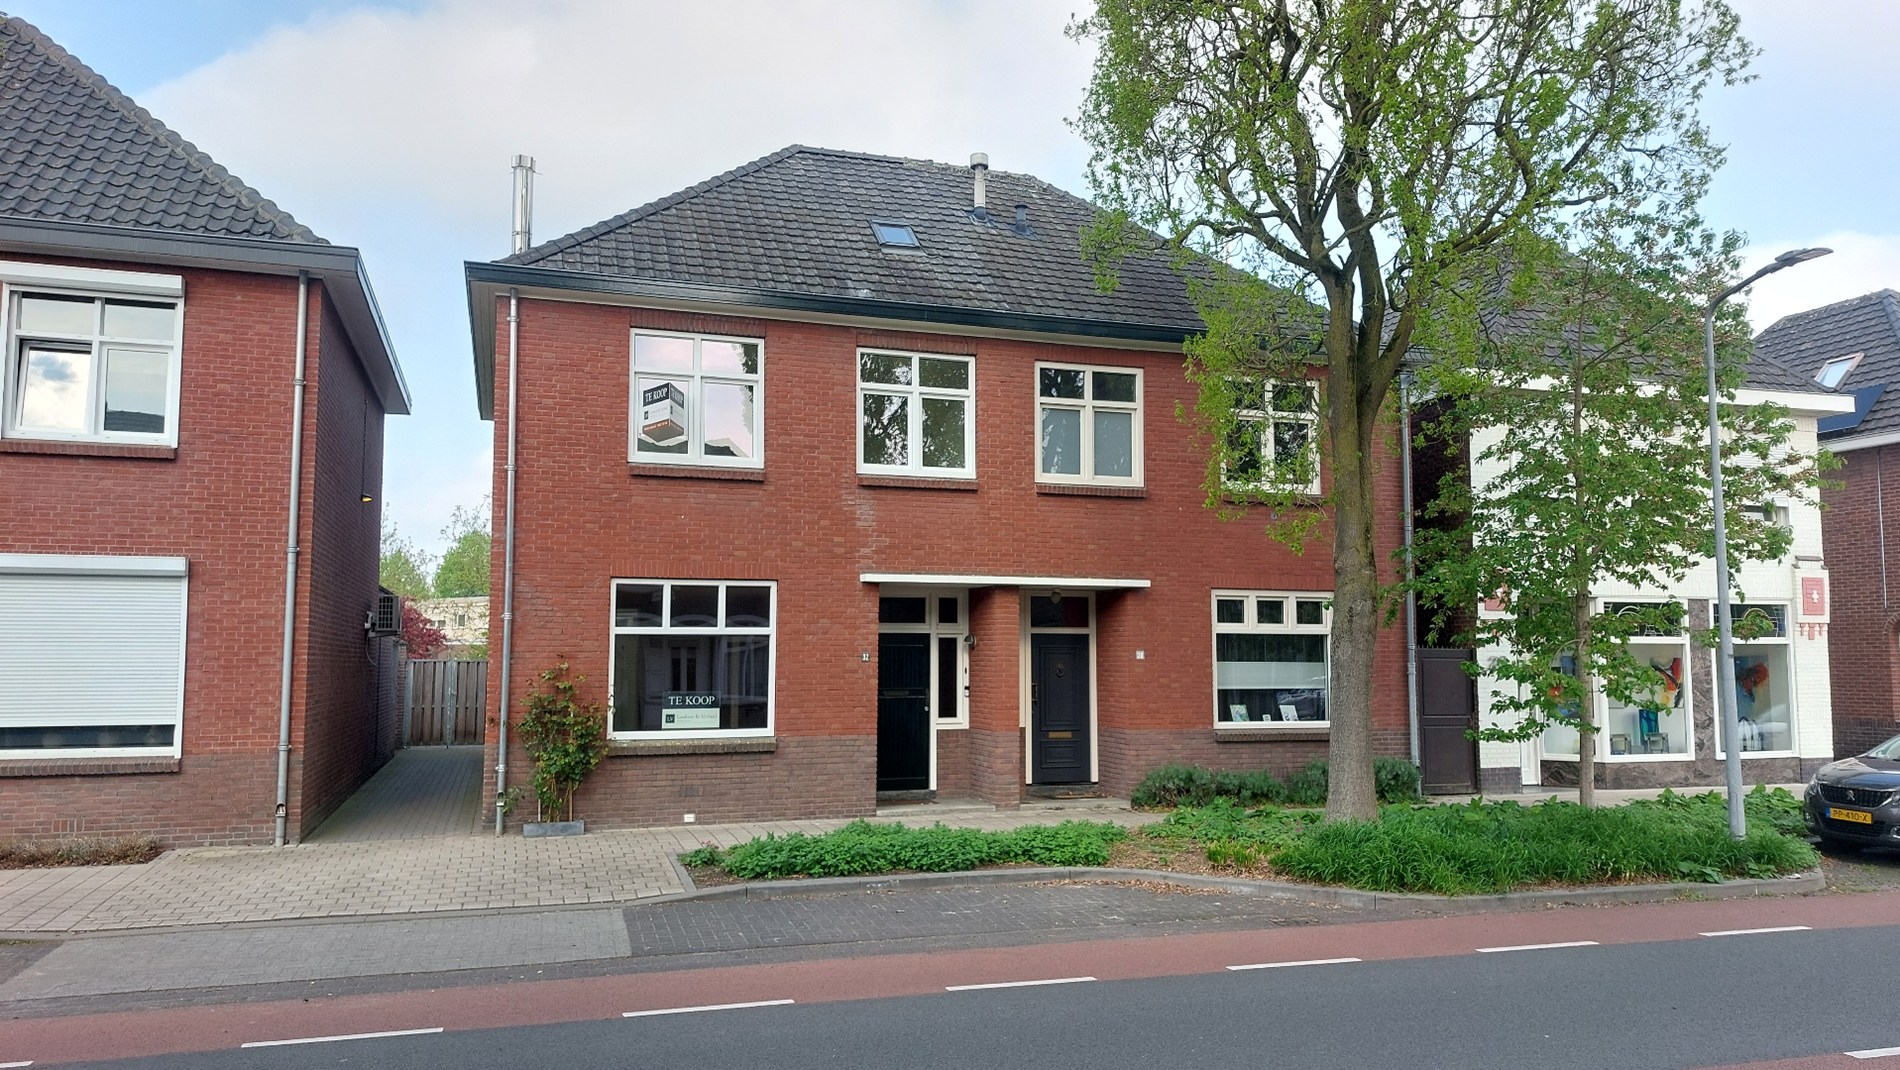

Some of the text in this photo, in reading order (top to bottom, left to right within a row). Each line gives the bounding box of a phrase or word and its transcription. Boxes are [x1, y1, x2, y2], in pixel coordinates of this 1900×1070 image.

[645, 387, 668, 402] TE KOOP
[668, 695, 716, 705] TE KOOP
